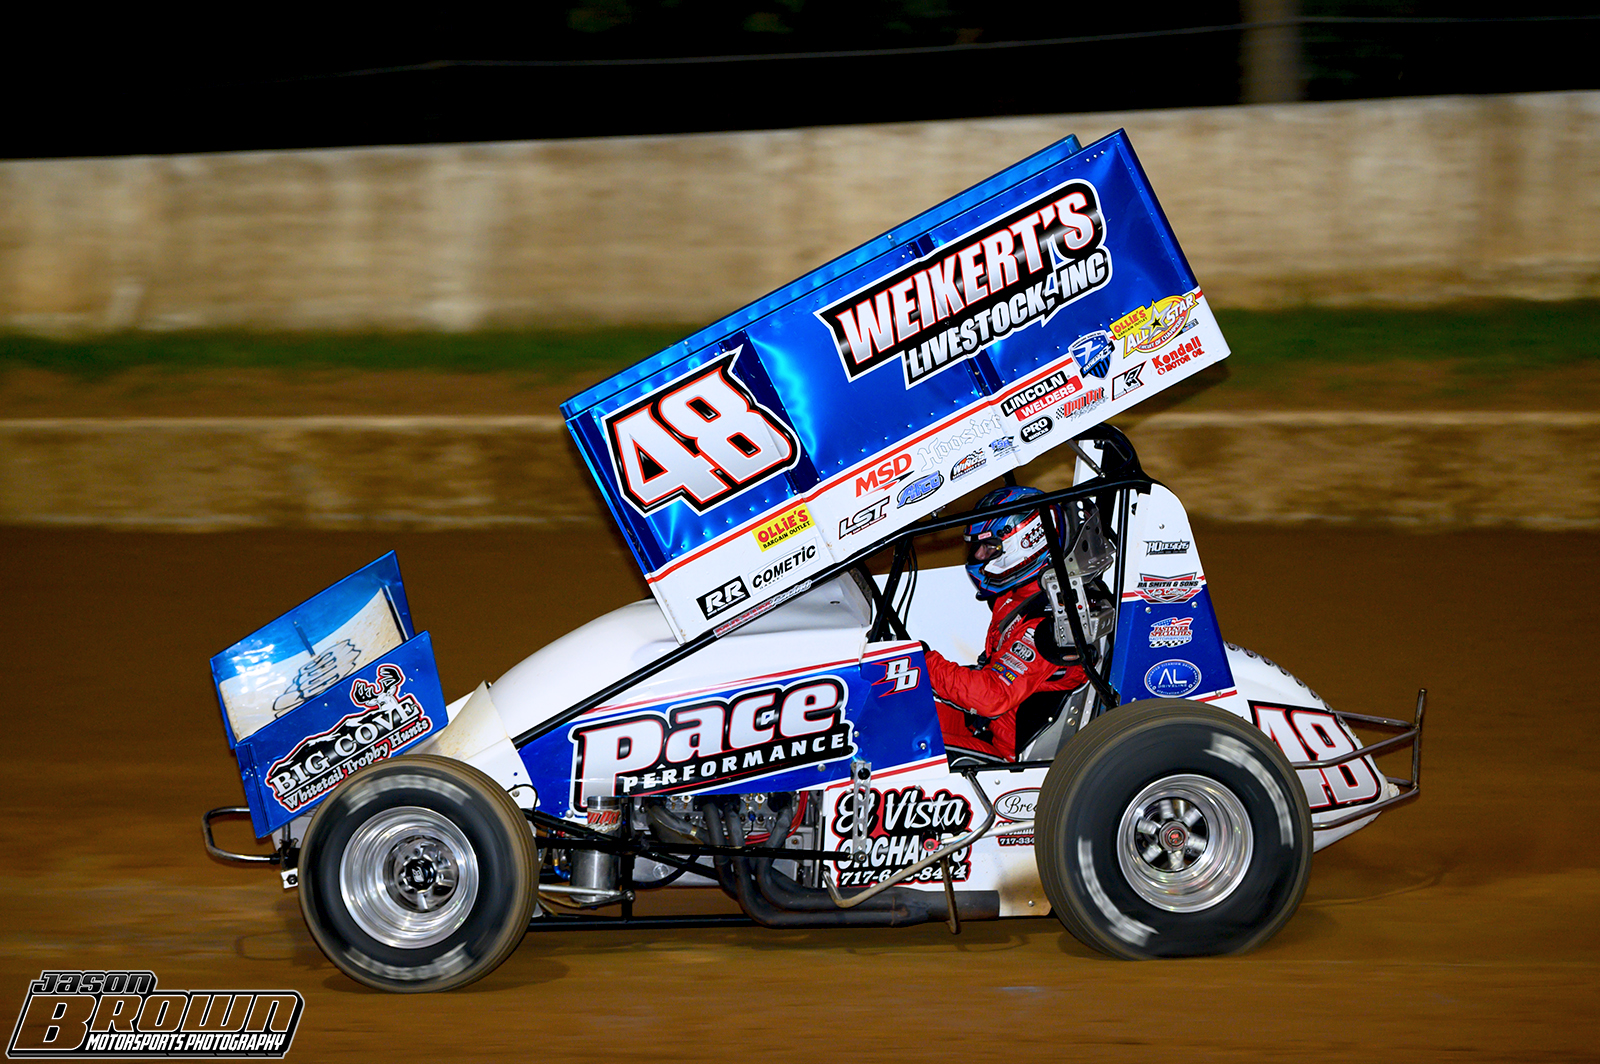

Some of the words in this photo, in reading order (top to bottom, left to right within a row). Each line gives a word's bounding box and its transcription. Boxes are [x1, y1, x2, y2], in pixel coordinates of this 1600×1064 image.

[837, 191, 1095, 365] WEIKERT'S
[1061, 252, 1108, 298] INC
[1166, 294, 1195, 327] STAR
[1151, 335, 1202, 369] Kendall
[1165, 354, 1192, 374] MOTOR
[1191, 347, 1206, 359] OIL
[1003, 373, 1065, 415] LINCOLN
[1020, 383, 1076, 417] WELDERS
[612, 366, 793, 506] 48
[916, 413, 1002, 472] Hoosier
[1021, 418, 1048, 437] PRO
[855, 453, 912, 498] MSD
[762, 532, 789, 549] BARGAIN
[788, 520, 811, 535] OUTLET
[839, 496, 890, 539] LST
[752, 545, 816, 588] COMETIC
[705, 580, 745, 613] RR
[269, 751, 330, 797] BIG
[335, 697, 420, 757] COVE
[283, 765, 344, 809] Whitetail
[343, 742, 389, 775] Trophy
[388, 718, 429, 754] Hunts
[579, 683, 838, 808] Pace
[618, 733, 845, 793] PERFORMANCE
[1254, 705, 1379, 808] 48
[884, 789, 965, 831] Vista
